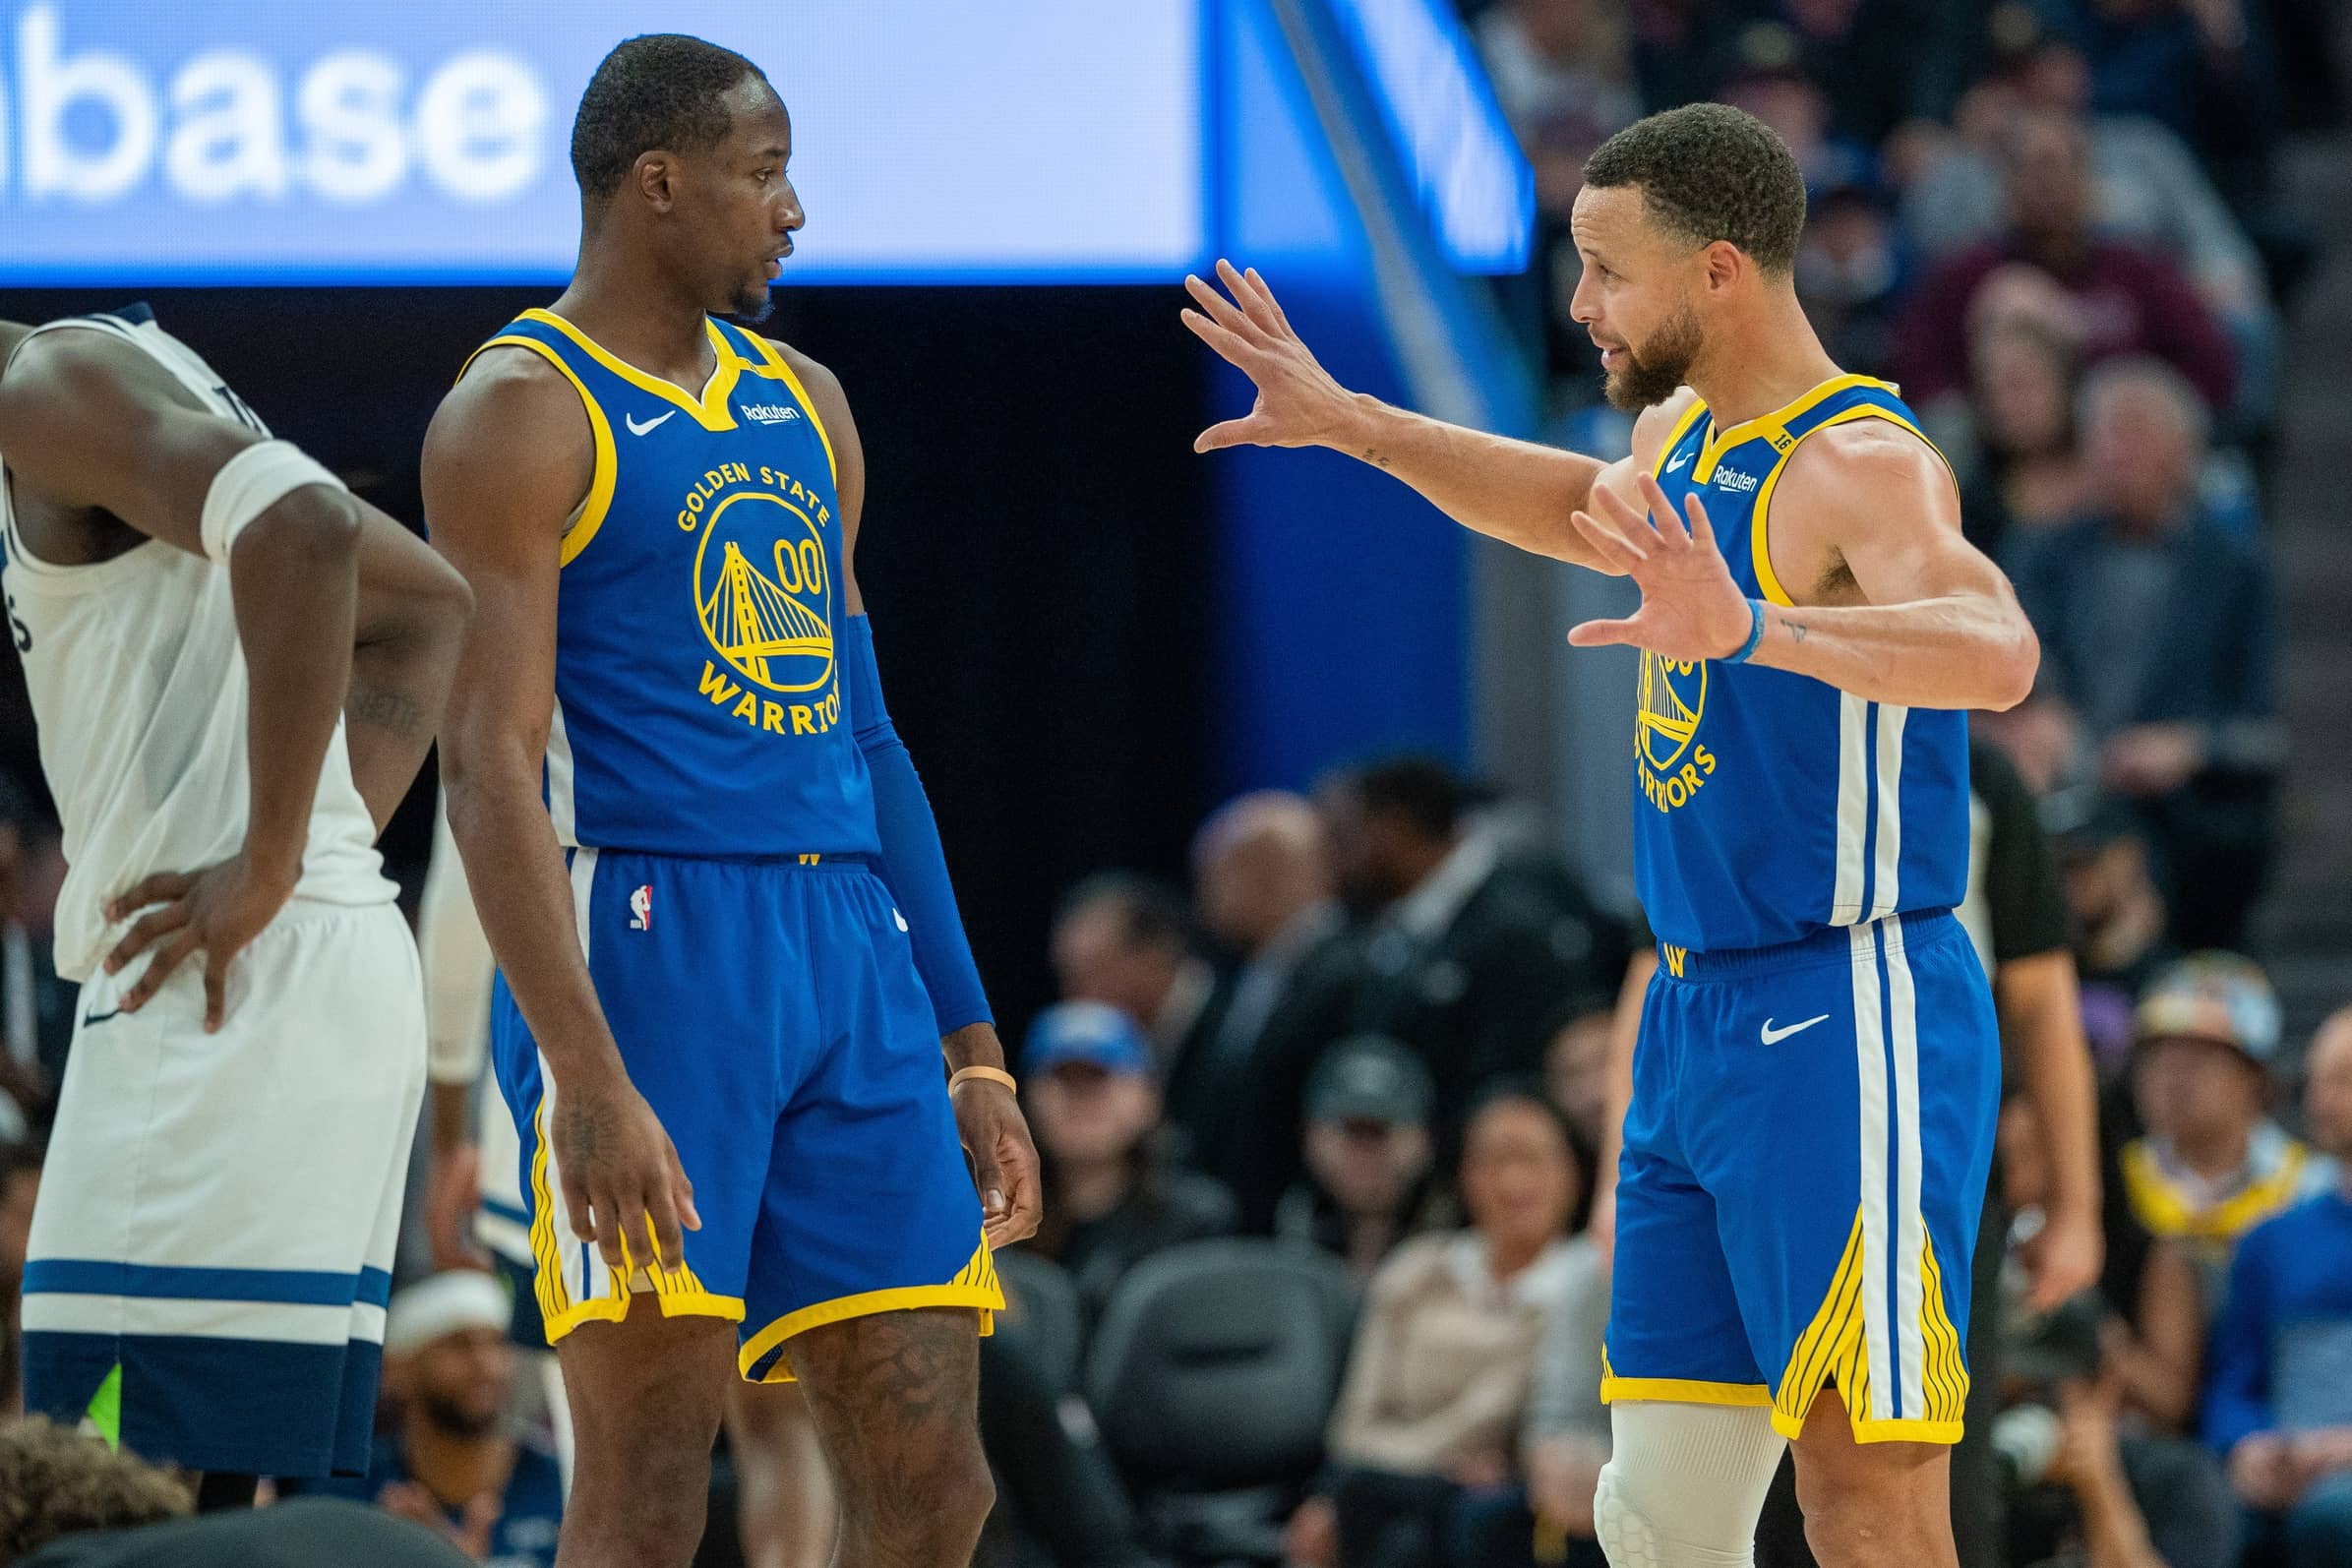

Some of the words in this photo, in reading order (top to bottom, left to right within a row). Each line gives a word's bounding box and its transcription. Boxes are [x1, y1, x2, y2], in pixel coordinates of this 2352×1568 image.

[0, 3, 544, 200] base
[740, 402, 802, 422] Rakuten
[677, 462, 752, 532] GOLDEN
[759, 465, 831, 528] STATE
[1713, 464, 1758, 492] Rakuten
[773, 539, 822, 595] 00
[698, 659, 841, 736] WARRIO
